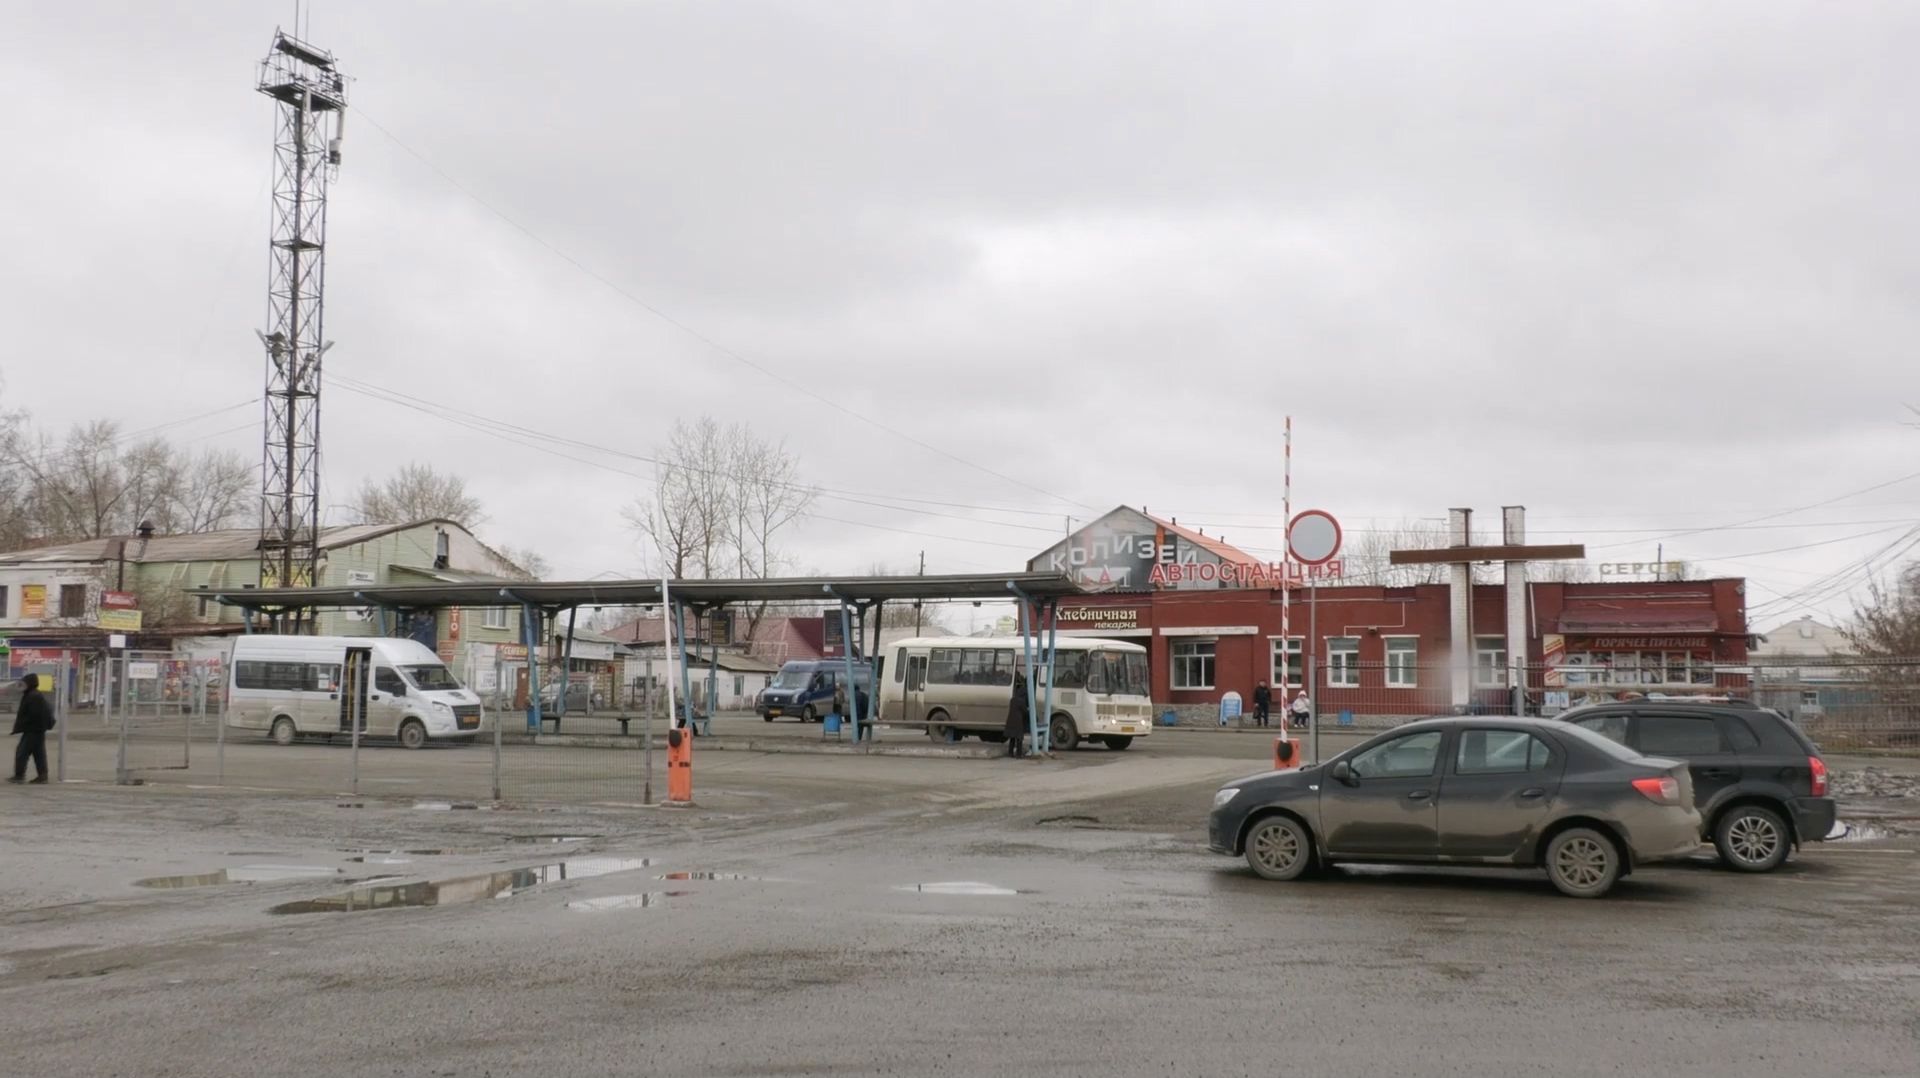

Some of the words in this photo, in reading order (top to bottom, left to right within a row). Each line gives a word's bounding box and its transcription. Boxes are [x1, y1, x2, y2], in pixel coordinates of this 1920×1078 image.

[1050, 535, 1197, 572] КОЛИЗЕЙ
[1149, 560, 1343, 583] АВТОСТАНЦИЯ
[1055, 608, 1137, 621] Хлебничная
[1094, 621, 1137, 630] пекарня
[1595, 638, 1647, 648] ГОРЯЧЕЕ
[1650, 637, 1707, 648] ПИТАНИЕ
